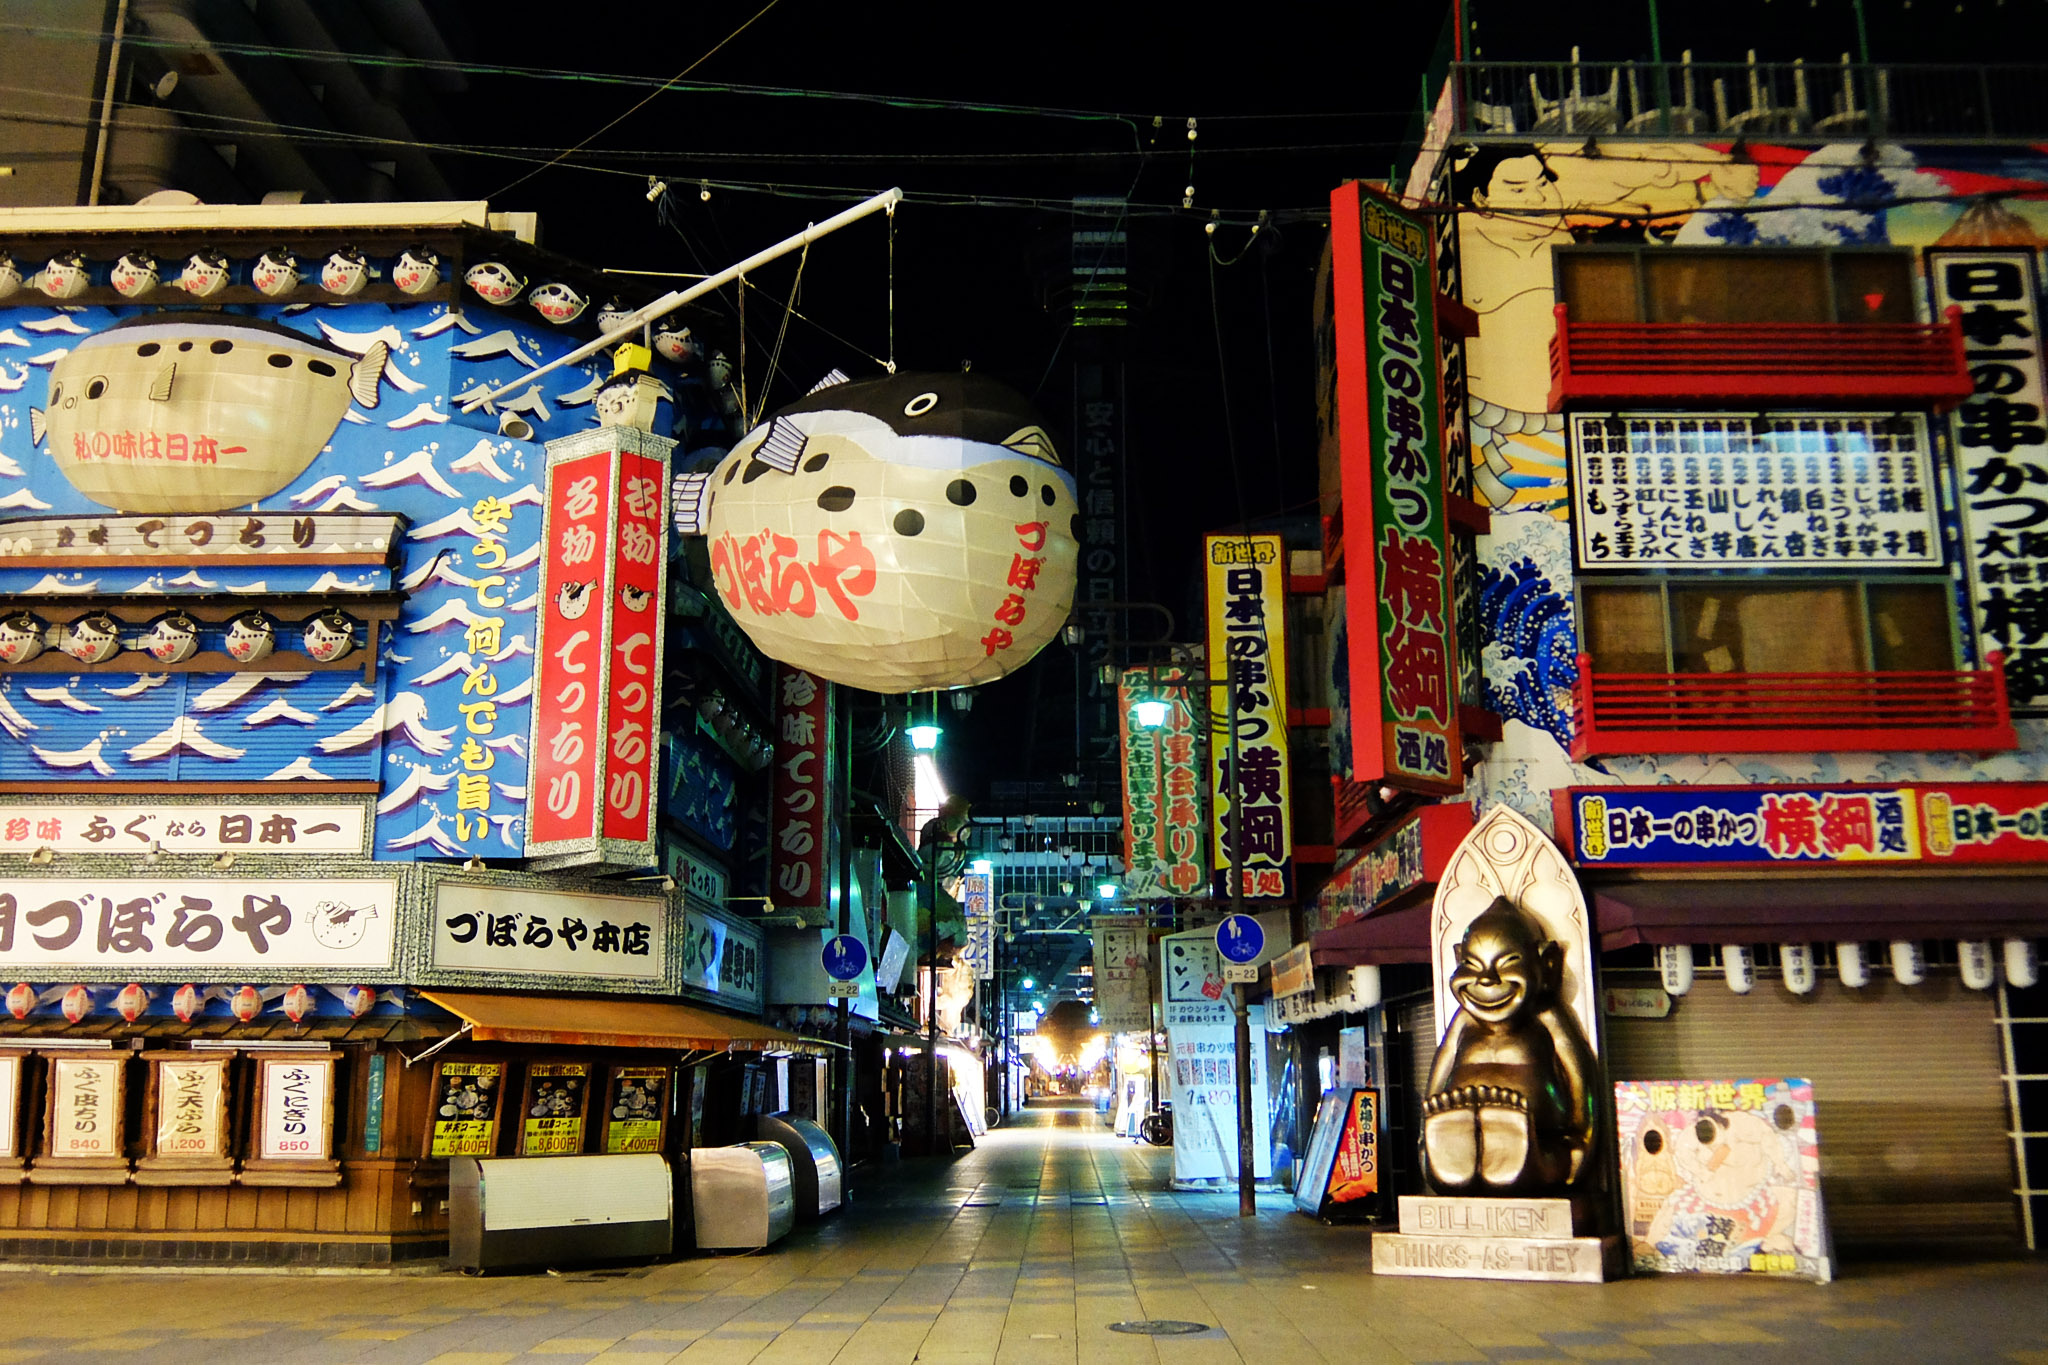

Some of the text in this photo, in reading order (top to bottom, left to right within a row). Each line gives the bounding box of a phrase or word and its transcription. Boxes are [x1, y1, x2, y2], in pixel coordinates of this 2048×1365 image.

[1366, 202, 1426, 263] 新世界
[1379, 248, 1429, 527] 日本一の串かつ
[73, 431, 248, 464] 私の味は日本一
[561, 475, 599, 567] 名物
[621, 475, 659, 567] 名物
[1212, 542, 1275, 564] 新世界
[1587, 488, 1610, 558] もち
[1635, 488, 1660, 558] 紅しょうが
[1659, 489, 1683, 558] にんにく
[1684, 488, 1708, 558] 玉ねぎ
[1708, 488, 1733, 558] 山芋
[1757, 488, 1782, 557] れんこん
[1806, 488, 1830, 557] 白ねぎ
[711, 526, 877, 621] づぼらや
[980, 520, 1050, 657] づぼらや
[1226, 568, 1270, 741] 日本一の串かつ
[1381, 526, 1448, 728] 横綱
[456, 496, 512, 842] 安うて何んでも旨い
[1123, 671, 1158, 894] 広々したお座敷もあります!!
[1161, 668, 1199, 895] 大小宴会承り中
[1396, 729, 1448, 775] 酒処
[5, 813, 341, 844] 珍味 ふぐなら日本一
[1608, 811, 1759, 847] 日本一の串かつ
[1763, 793, 1874, 855] 横綱
[1876, 796, 1907, 854] 酒処
[967, 876, 986, 913] 麻雀
[446, 910, 652, 956] づぼらや本店
[830, 985, 858, 994] 9-22
[1226, 969, 1256, 979] 9-22
[1176, 1042, 1257, 1055] 元祖串カツ専店
[74, 1067, 101, 1133] ふぐ皮ちり
[175, 1070, 203, 1134] ふぐ天ぷら
[283, 1068, 310, 1135] ふぐにぎり
[1621, 1082, 1767, 1112] 大阪新世界
[70, 1139, 100, 1150] 840
[278, 1140, 309, 1151] 850
[448, 1140, 489, 1153] 5,400円
[538, 1137, 577, 1152] 8,600円
[1359, 1095, 1375, 1173] 本場の串かつ
[1417, 1203, 1550, 1232] BILLIKEN
